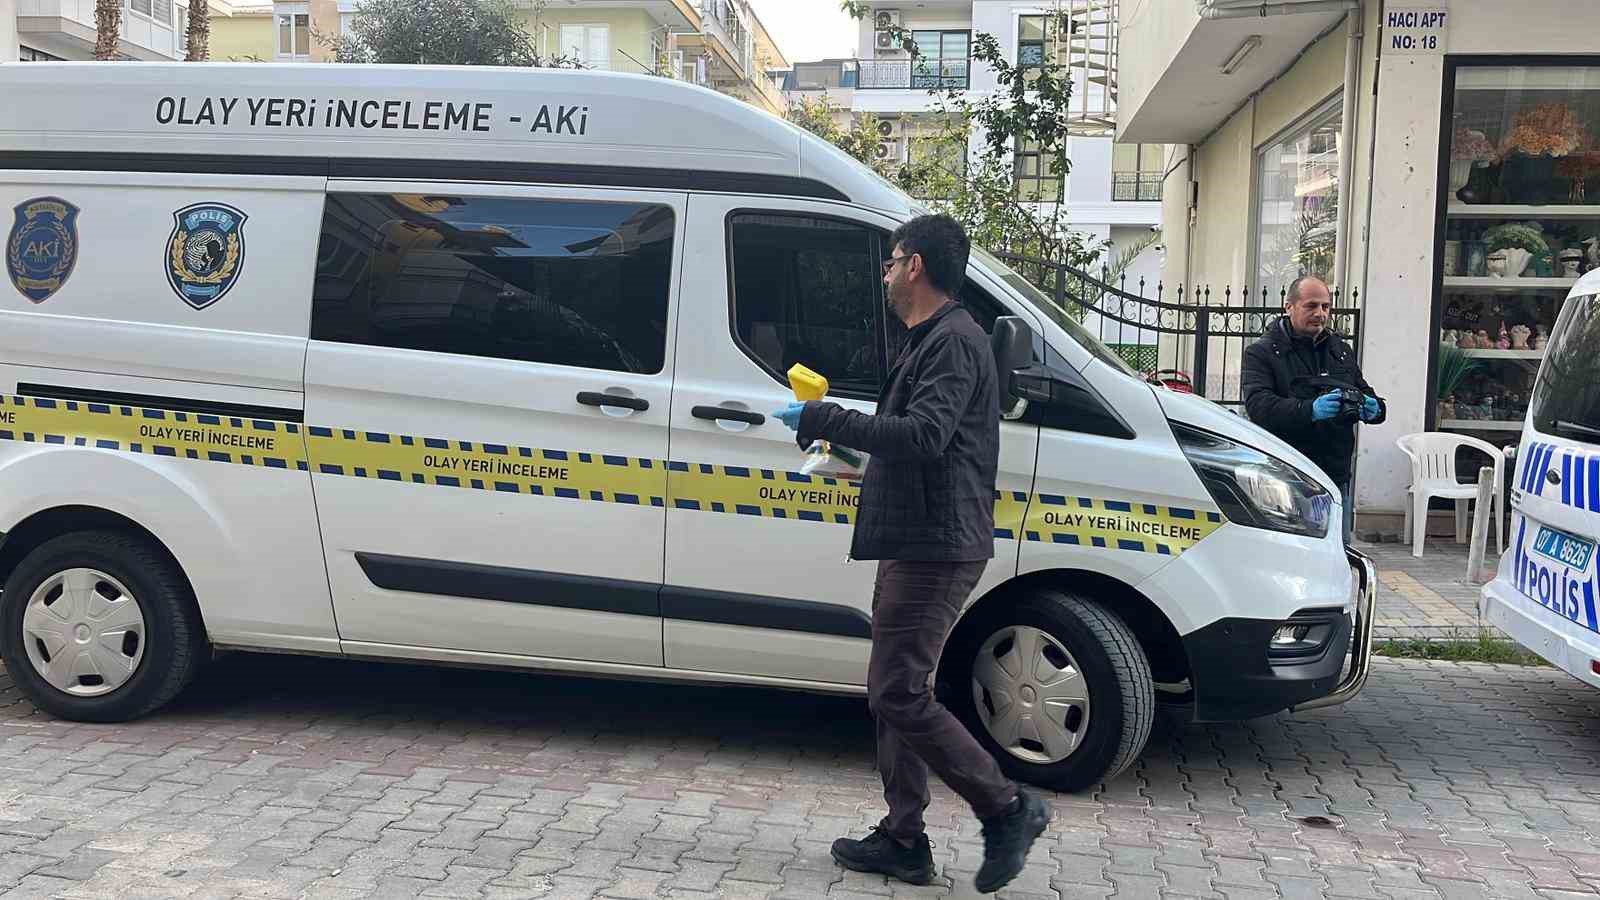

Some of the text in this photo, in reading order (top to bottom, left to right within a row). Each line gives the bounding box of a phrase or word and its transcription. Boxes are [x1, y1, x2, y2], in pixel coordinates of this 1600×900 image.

[1388, 12, 1446, 28] HACI APT
[1392, 35, 1437, 49] NO: 18
[156, 96, 239, 125] OLAY
[140, 424, 275, 450] OLAY YERİ İNCELEME
[424, 455, 569, 481] OLAY YERİ İNCELEME
[759, 486, 796, 502] OLAY
[800, 489, 832, 504] YERİ
[1044, 512, 1201, 541] OLAY YERİ İNCELEME
[1536, 530, 1588, 566] 07 A 8626
